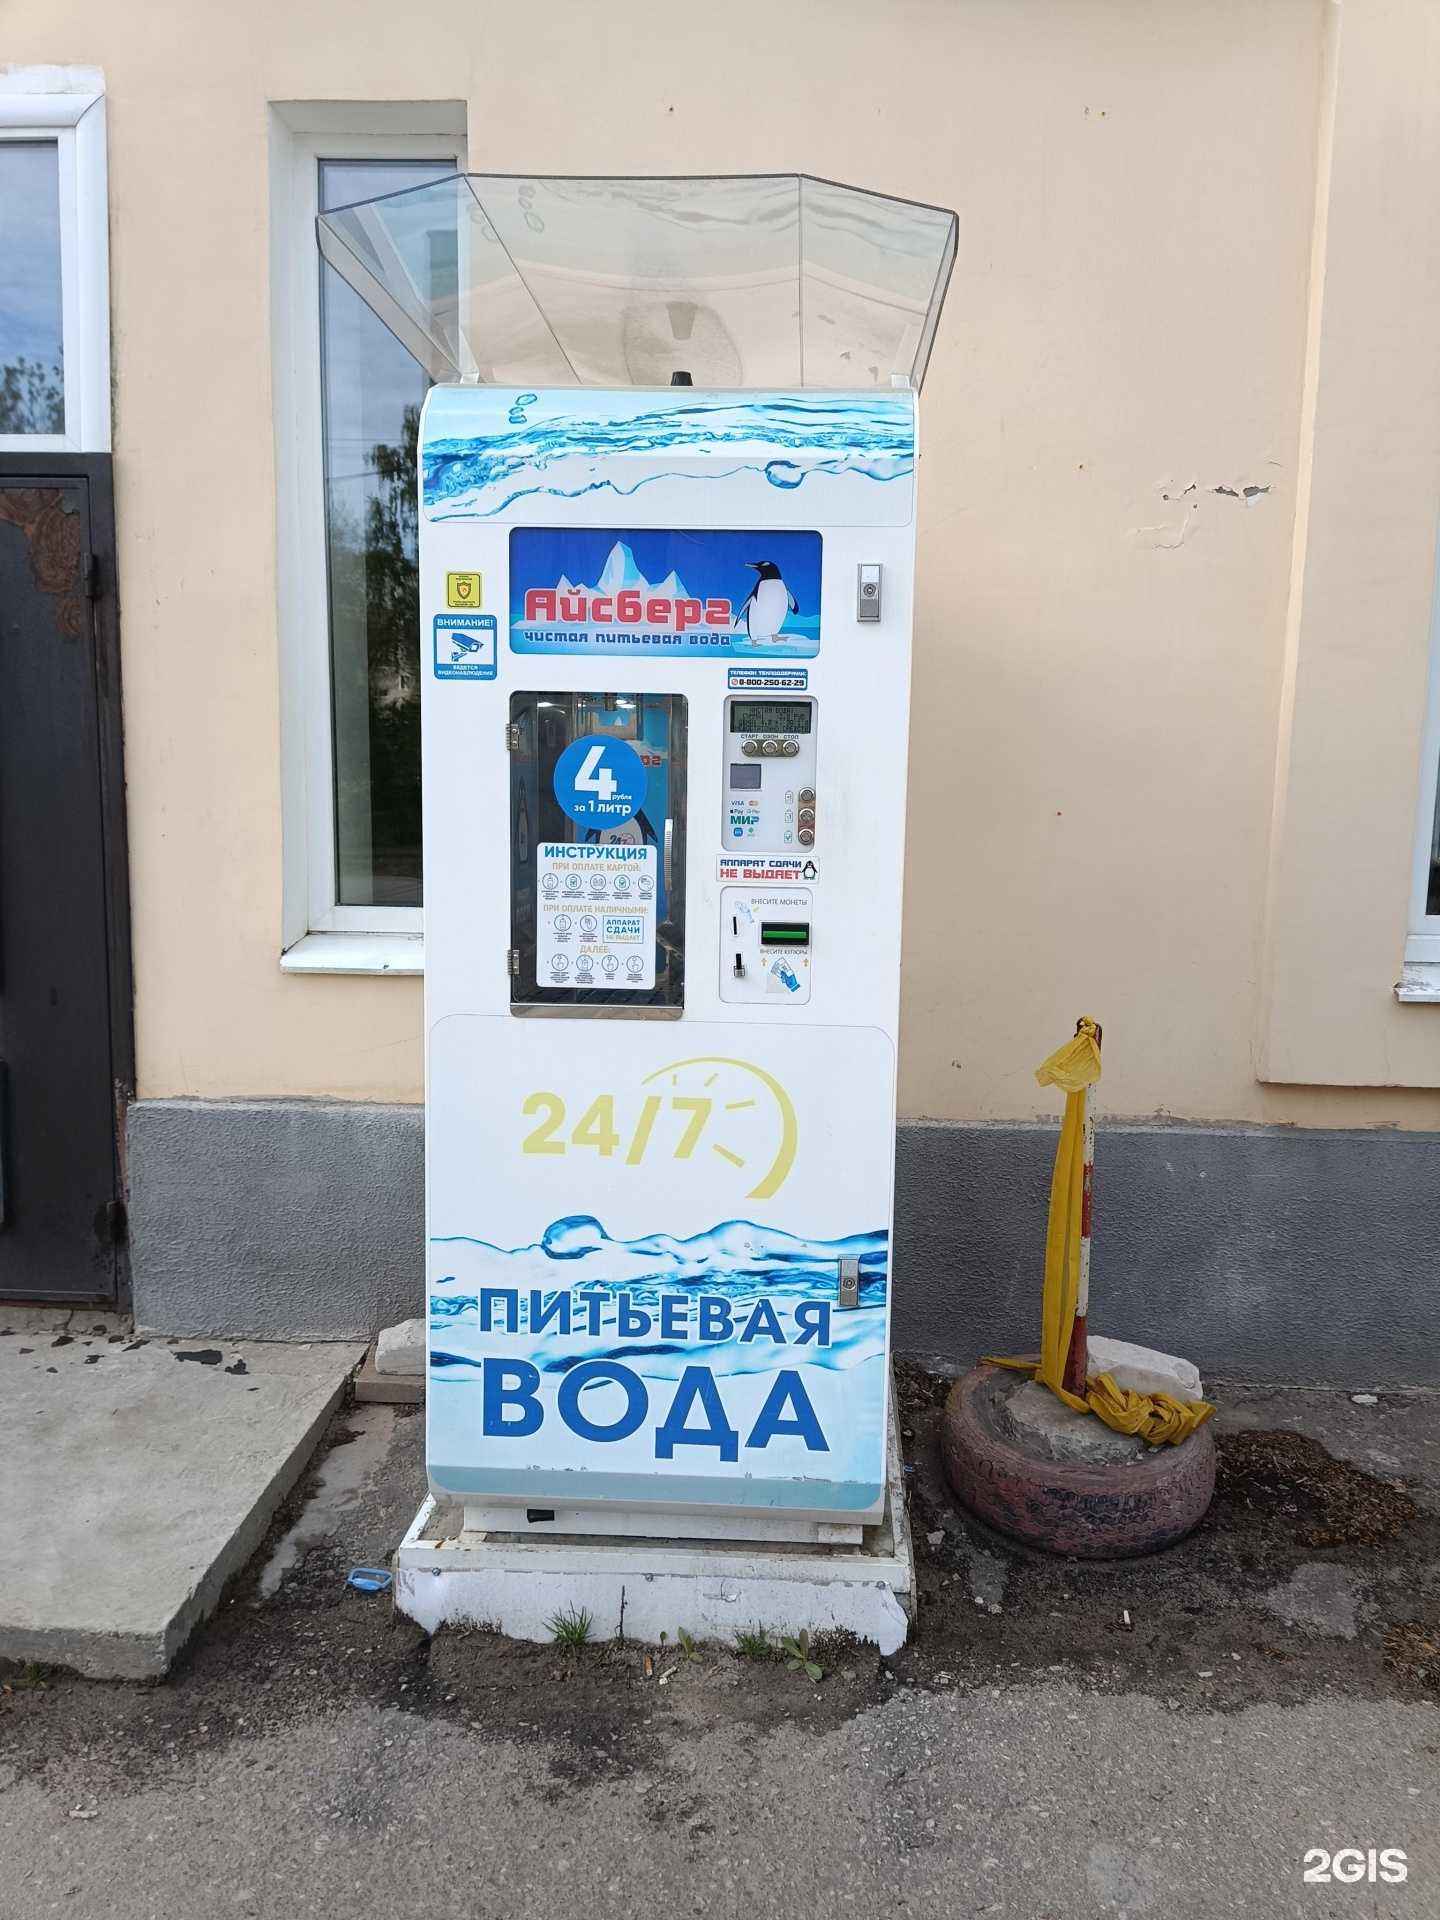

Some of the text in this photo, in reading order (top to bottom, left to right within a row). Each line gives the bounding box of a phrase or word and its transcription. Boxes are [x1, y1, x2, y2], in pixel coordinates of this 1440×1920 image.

[525, 588, 731, 632] Айсберг
[437, 618, 493, 627] ВНИМАНИЕ!
[524, 631, 730, 646] чистая питьевая вода
[574, 745, 618, 801] 4
[574, 800, 632, 816] за 1 литр
[730, 815, 760, 825] МИР
[544, 846, 647, 861] ИНСТРУКЦИЯ
[552, 862, 570, 871] ПРИ
[572, 863, 604, 871] ОПЛАТЕ
[720, 859, 802, 868] АППАРАТ СДАЧИ
[720, 868, 801, 879] НЕ ВЫДАЕТ
[543, 904, 559, 912] ПРИ
[562, 905, 592, 913] ОПЛАТЕ
[606, 926, 640, 934] СДАЧИ
[521, 1092, 712, 1165] 24/7
[480, 1288, 831, 1346] ПИТЬЕВАЯ
[483, 1358, 830, 1463] ВОДА
